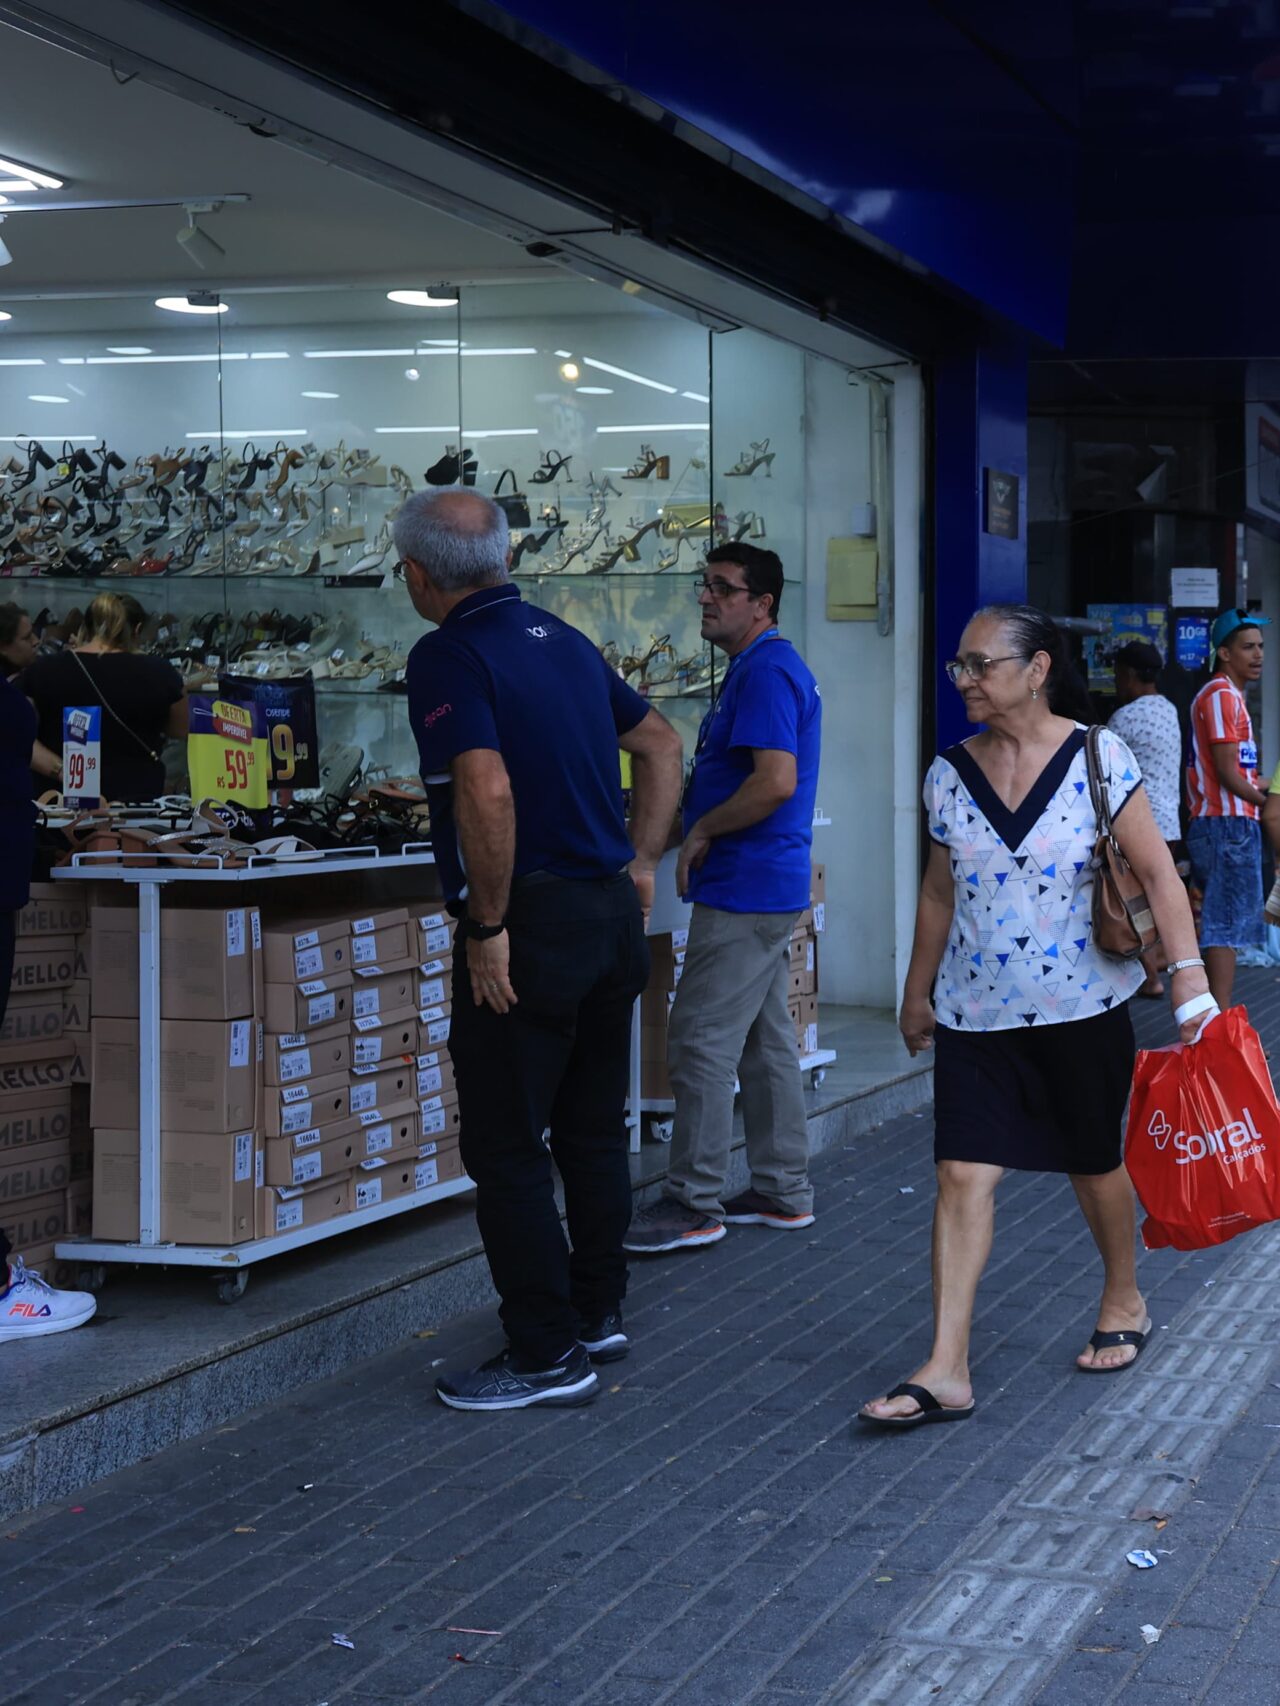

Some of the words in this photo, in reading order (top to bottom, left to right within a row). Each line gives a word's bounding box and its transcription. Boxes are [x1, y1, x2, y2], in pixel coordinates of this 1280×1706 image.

[69, 753, 84, 789] 99
[224, 749, 248, 789] 59
[0, 1013, 61, 1039] ELLO
[9, 1303, 52, 1317] FILA
